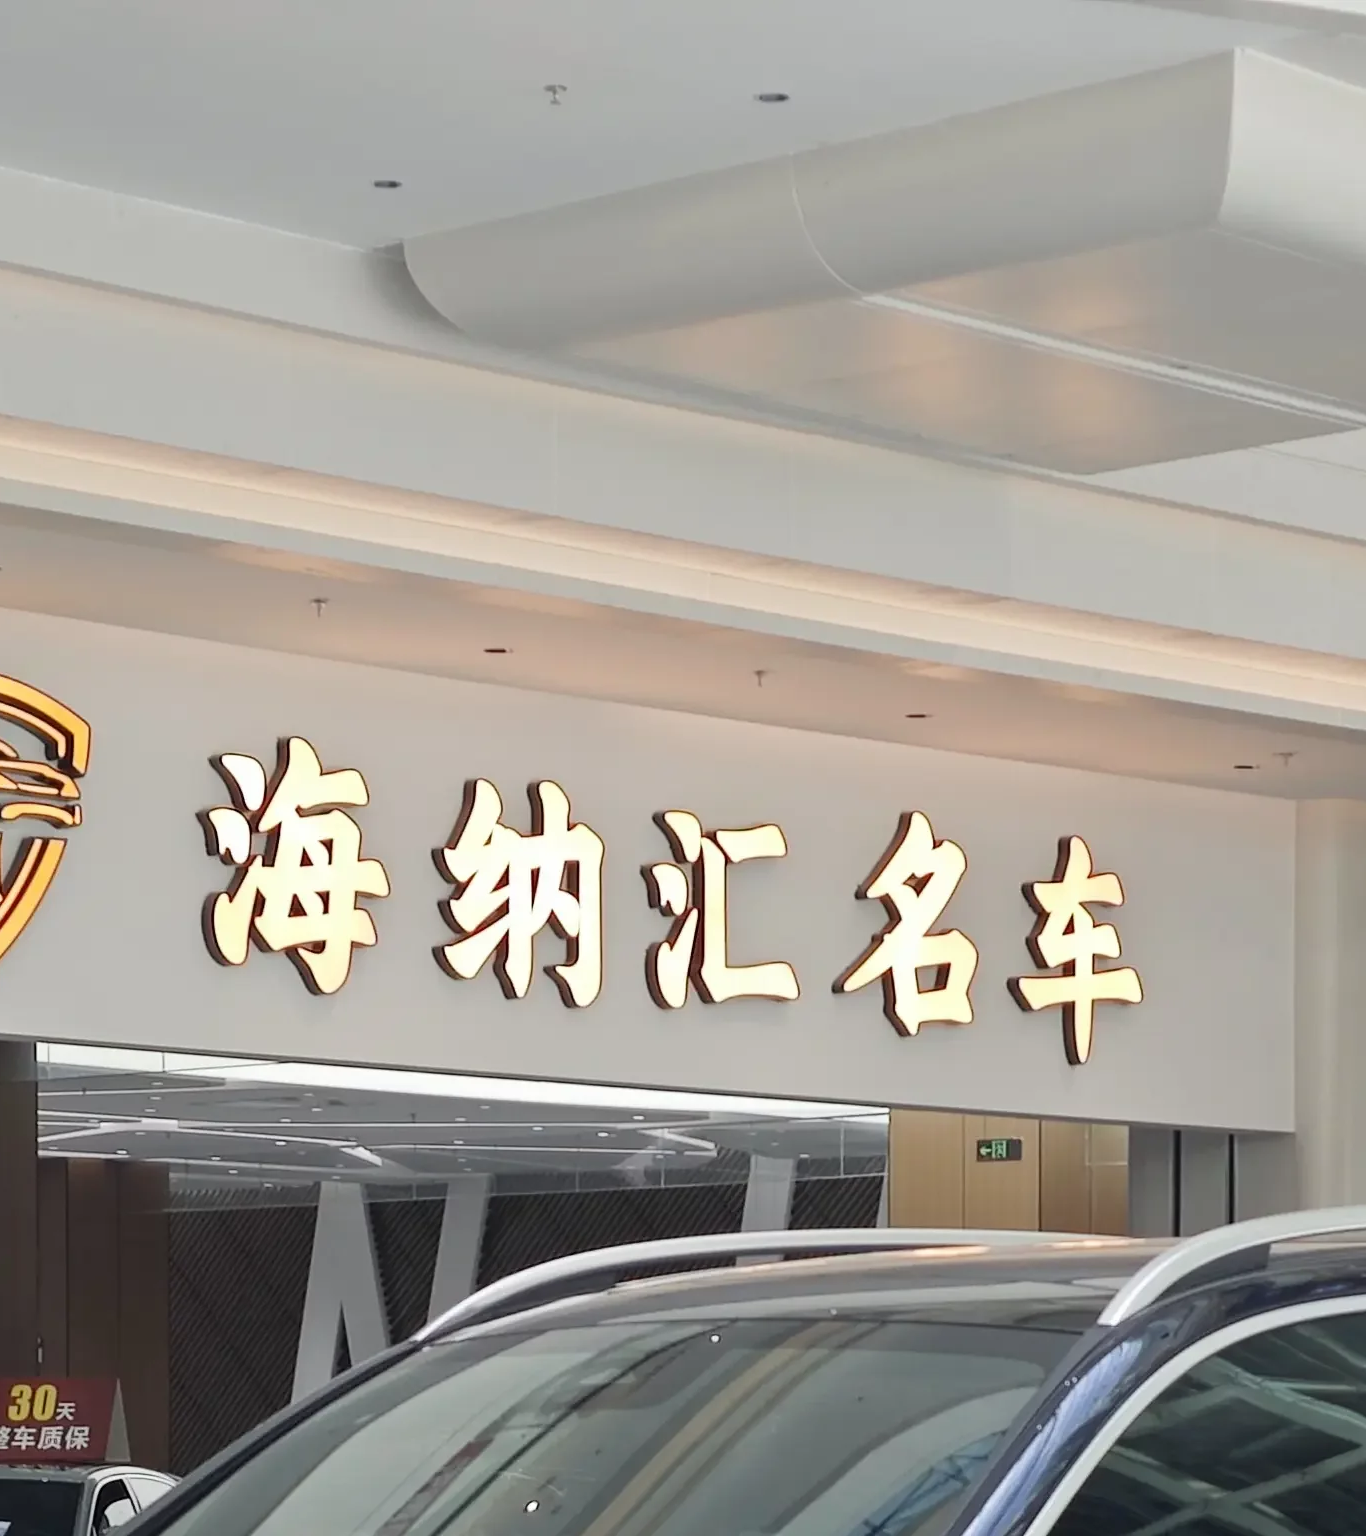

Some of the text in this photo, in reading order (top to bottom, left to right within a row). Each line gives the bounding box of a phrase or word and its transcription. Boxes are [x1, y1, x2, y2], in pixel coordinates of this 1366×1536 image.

[196, 735, 1144, 1066] 海纳汇名车
[6, 1383, 76, 1422] 30天
